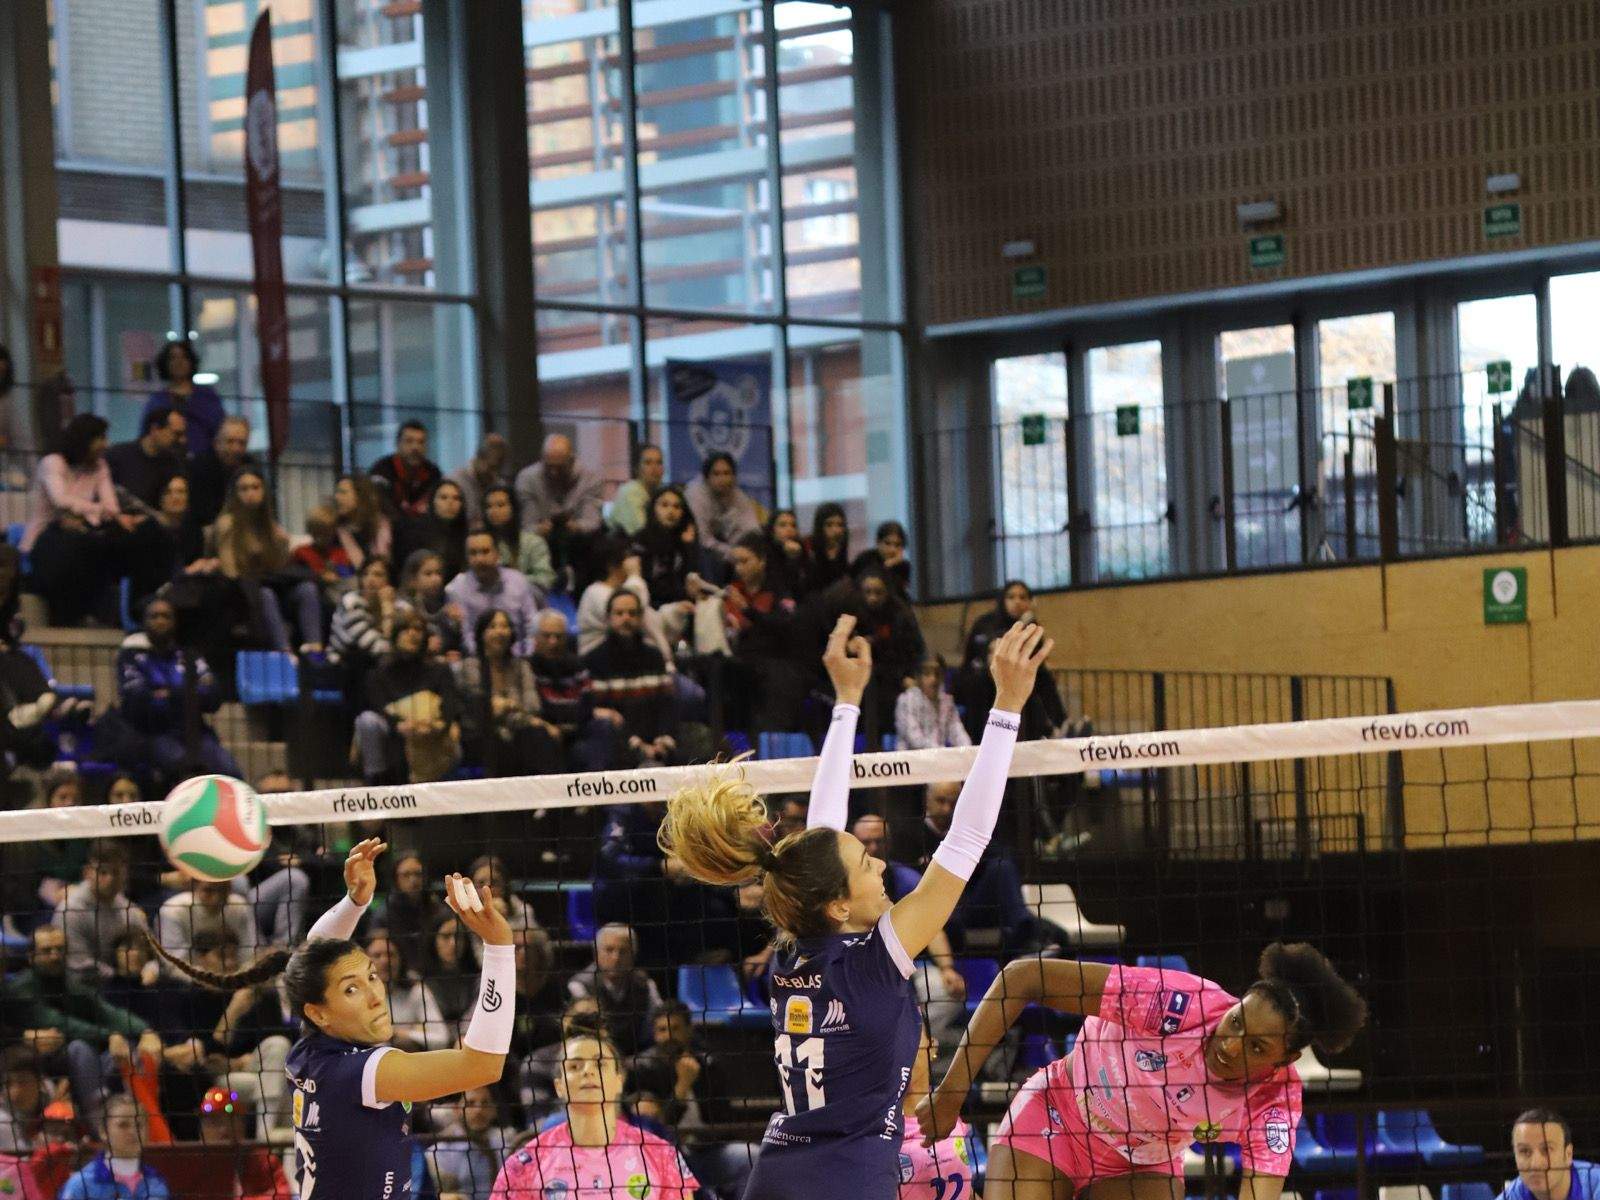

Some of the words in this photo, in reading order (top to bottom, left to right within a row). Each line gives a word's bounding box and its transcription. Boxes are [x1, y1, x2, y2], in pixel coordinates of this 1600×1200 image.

[1361, 719, 1470, 742] rfevb.com
[1079, 740, 1181, 762] rfevb.com
[567, 776, 656, 798] rfevb.com
[333, 792, 417, 813] rfevb.com
[774, 1033, 826, 1117] 11
